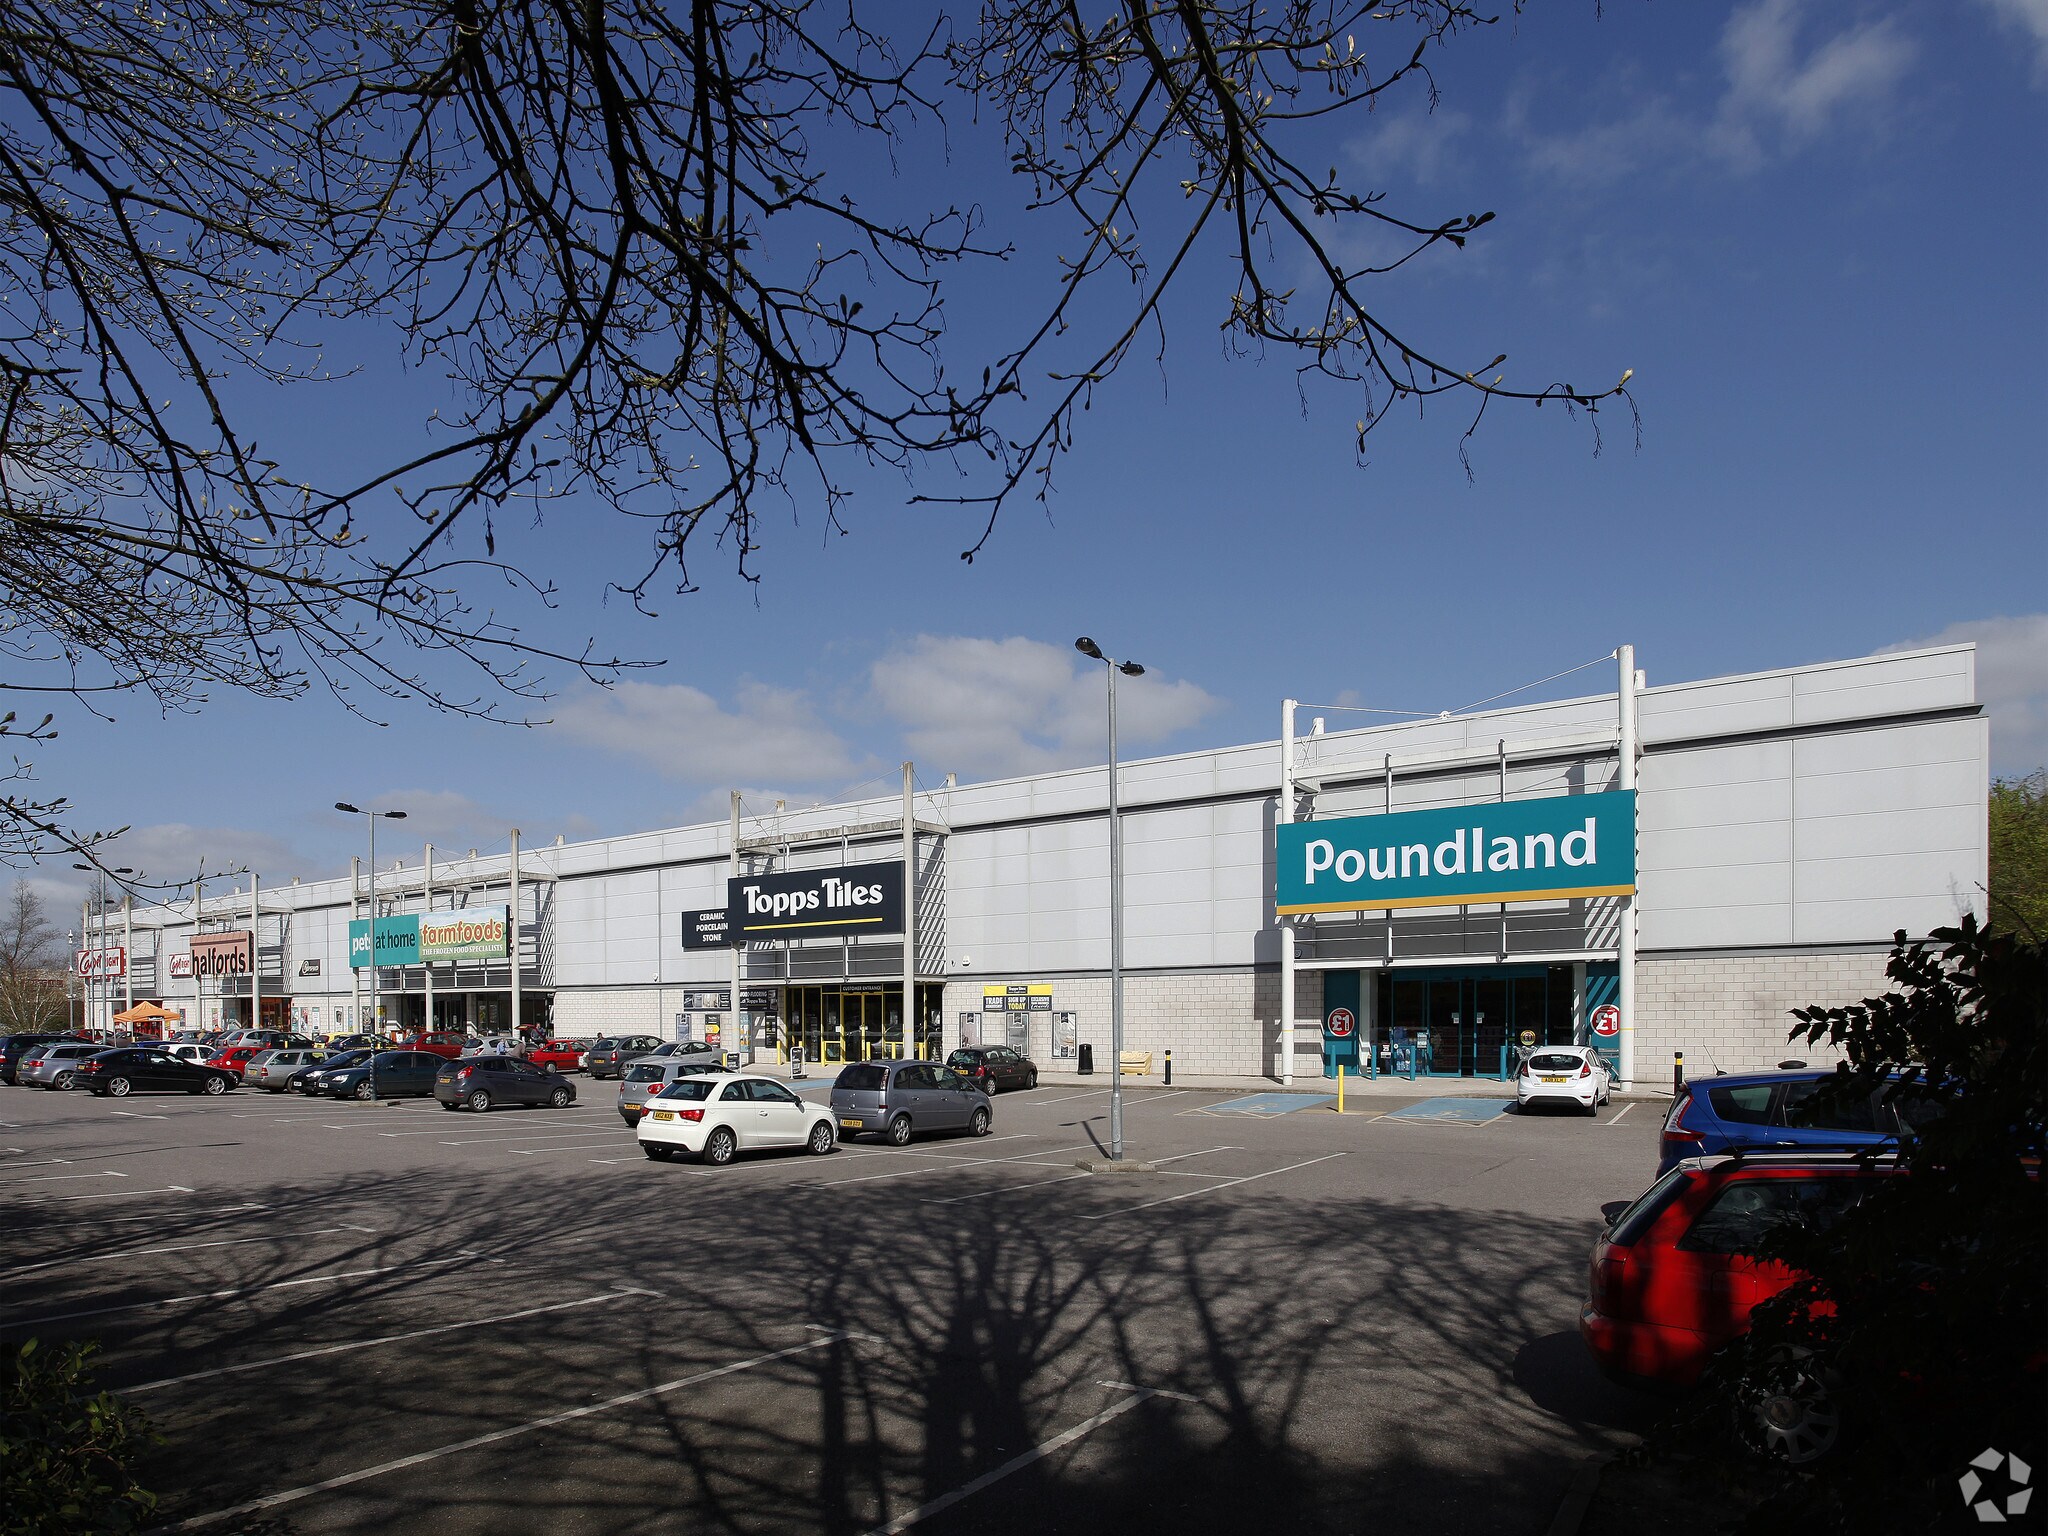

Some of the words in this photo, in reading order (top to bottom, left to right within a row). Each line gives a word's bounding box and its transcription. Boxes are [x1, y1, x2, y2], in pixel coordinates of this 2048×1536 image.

[1305, 817, 1597, 885] Poundland
[743, 885, 820, 917] Topps
[821, 877, 884, 908] Tiles
[700, 912, 725, 921] CERAMIC
[422, 917, 504, 946] farmfoods
[696, 922, 729, 932] PORCELAIN
[376, 931, 386, 950] at
[387, 929, 416, 949] home
[702, 933, 722, 942] STONE
[422, 948, 433, 956] THE
[433, 946, 454, 955] FROZEN
[454, 946, 469, 954] FOOD
[469, 944, 503, 953] SPECIALISTS
[191, 945, 247, 976] halfords
[1008, 1002, 1026, 1010] TODAY
[1332, 1014, 1350, 1031] £1
[1595, 1011, 1618, 1031] £1
